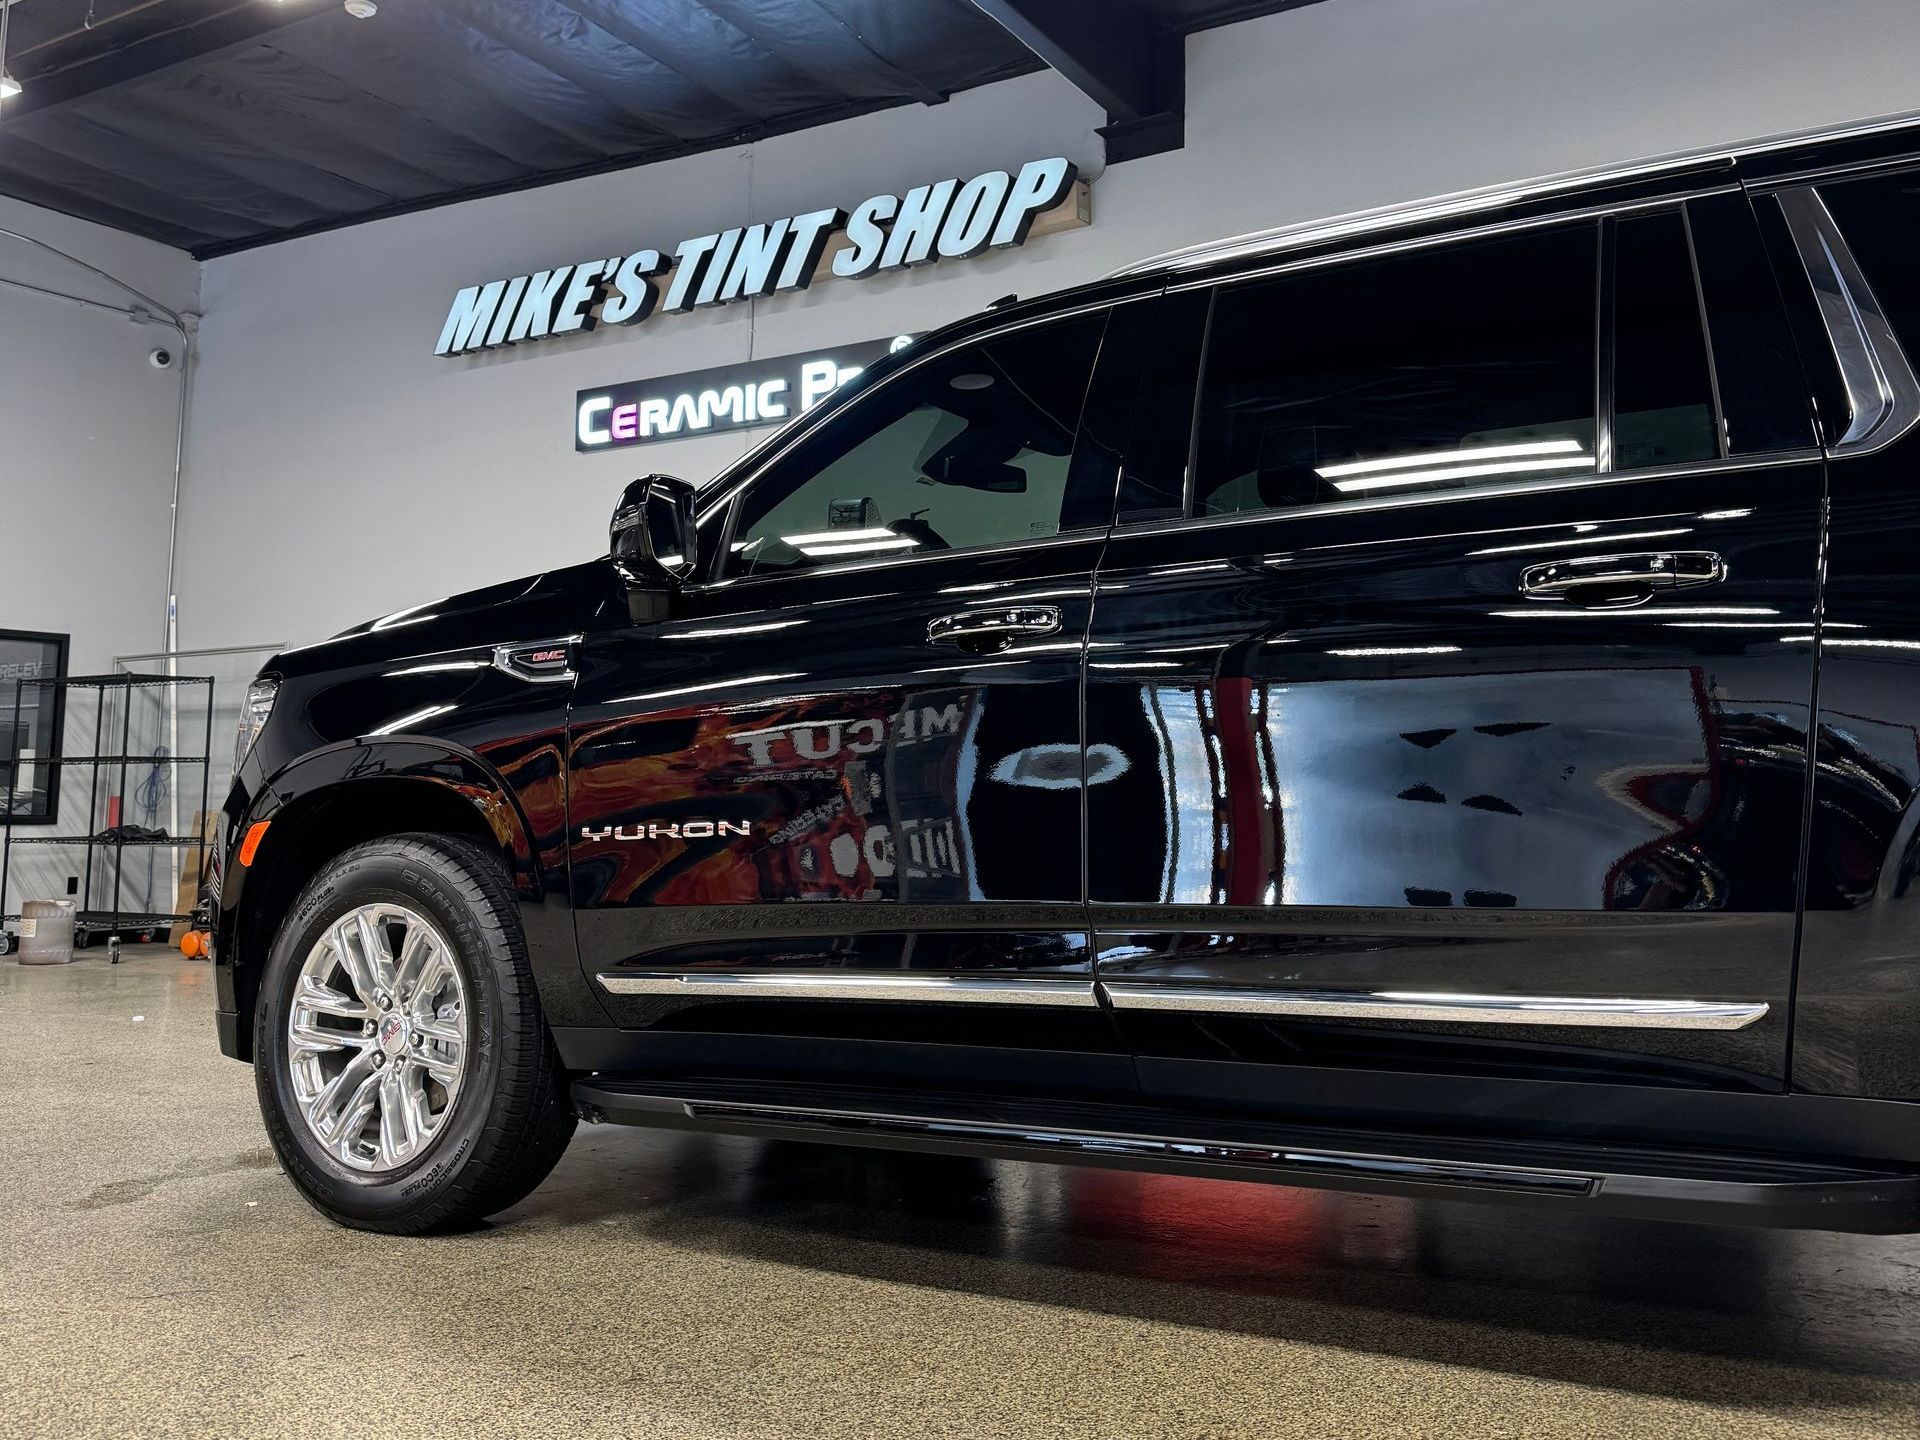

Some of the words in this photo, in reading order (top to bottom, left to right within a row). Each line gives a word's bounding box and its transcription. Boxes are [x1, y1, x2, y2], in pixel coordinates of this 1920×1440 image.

[434, 249, 661, 356] MIKE'S
[661, 206, 842, 312] TINT
[831, 157, 1072, 277] SHOP
[579, 379, 786, 444] CERAMIC
[532, 649, 566, 662] GMC
[581, 820, 751, 842] YUKON
[381, 1020, 401, 1046] GMC
